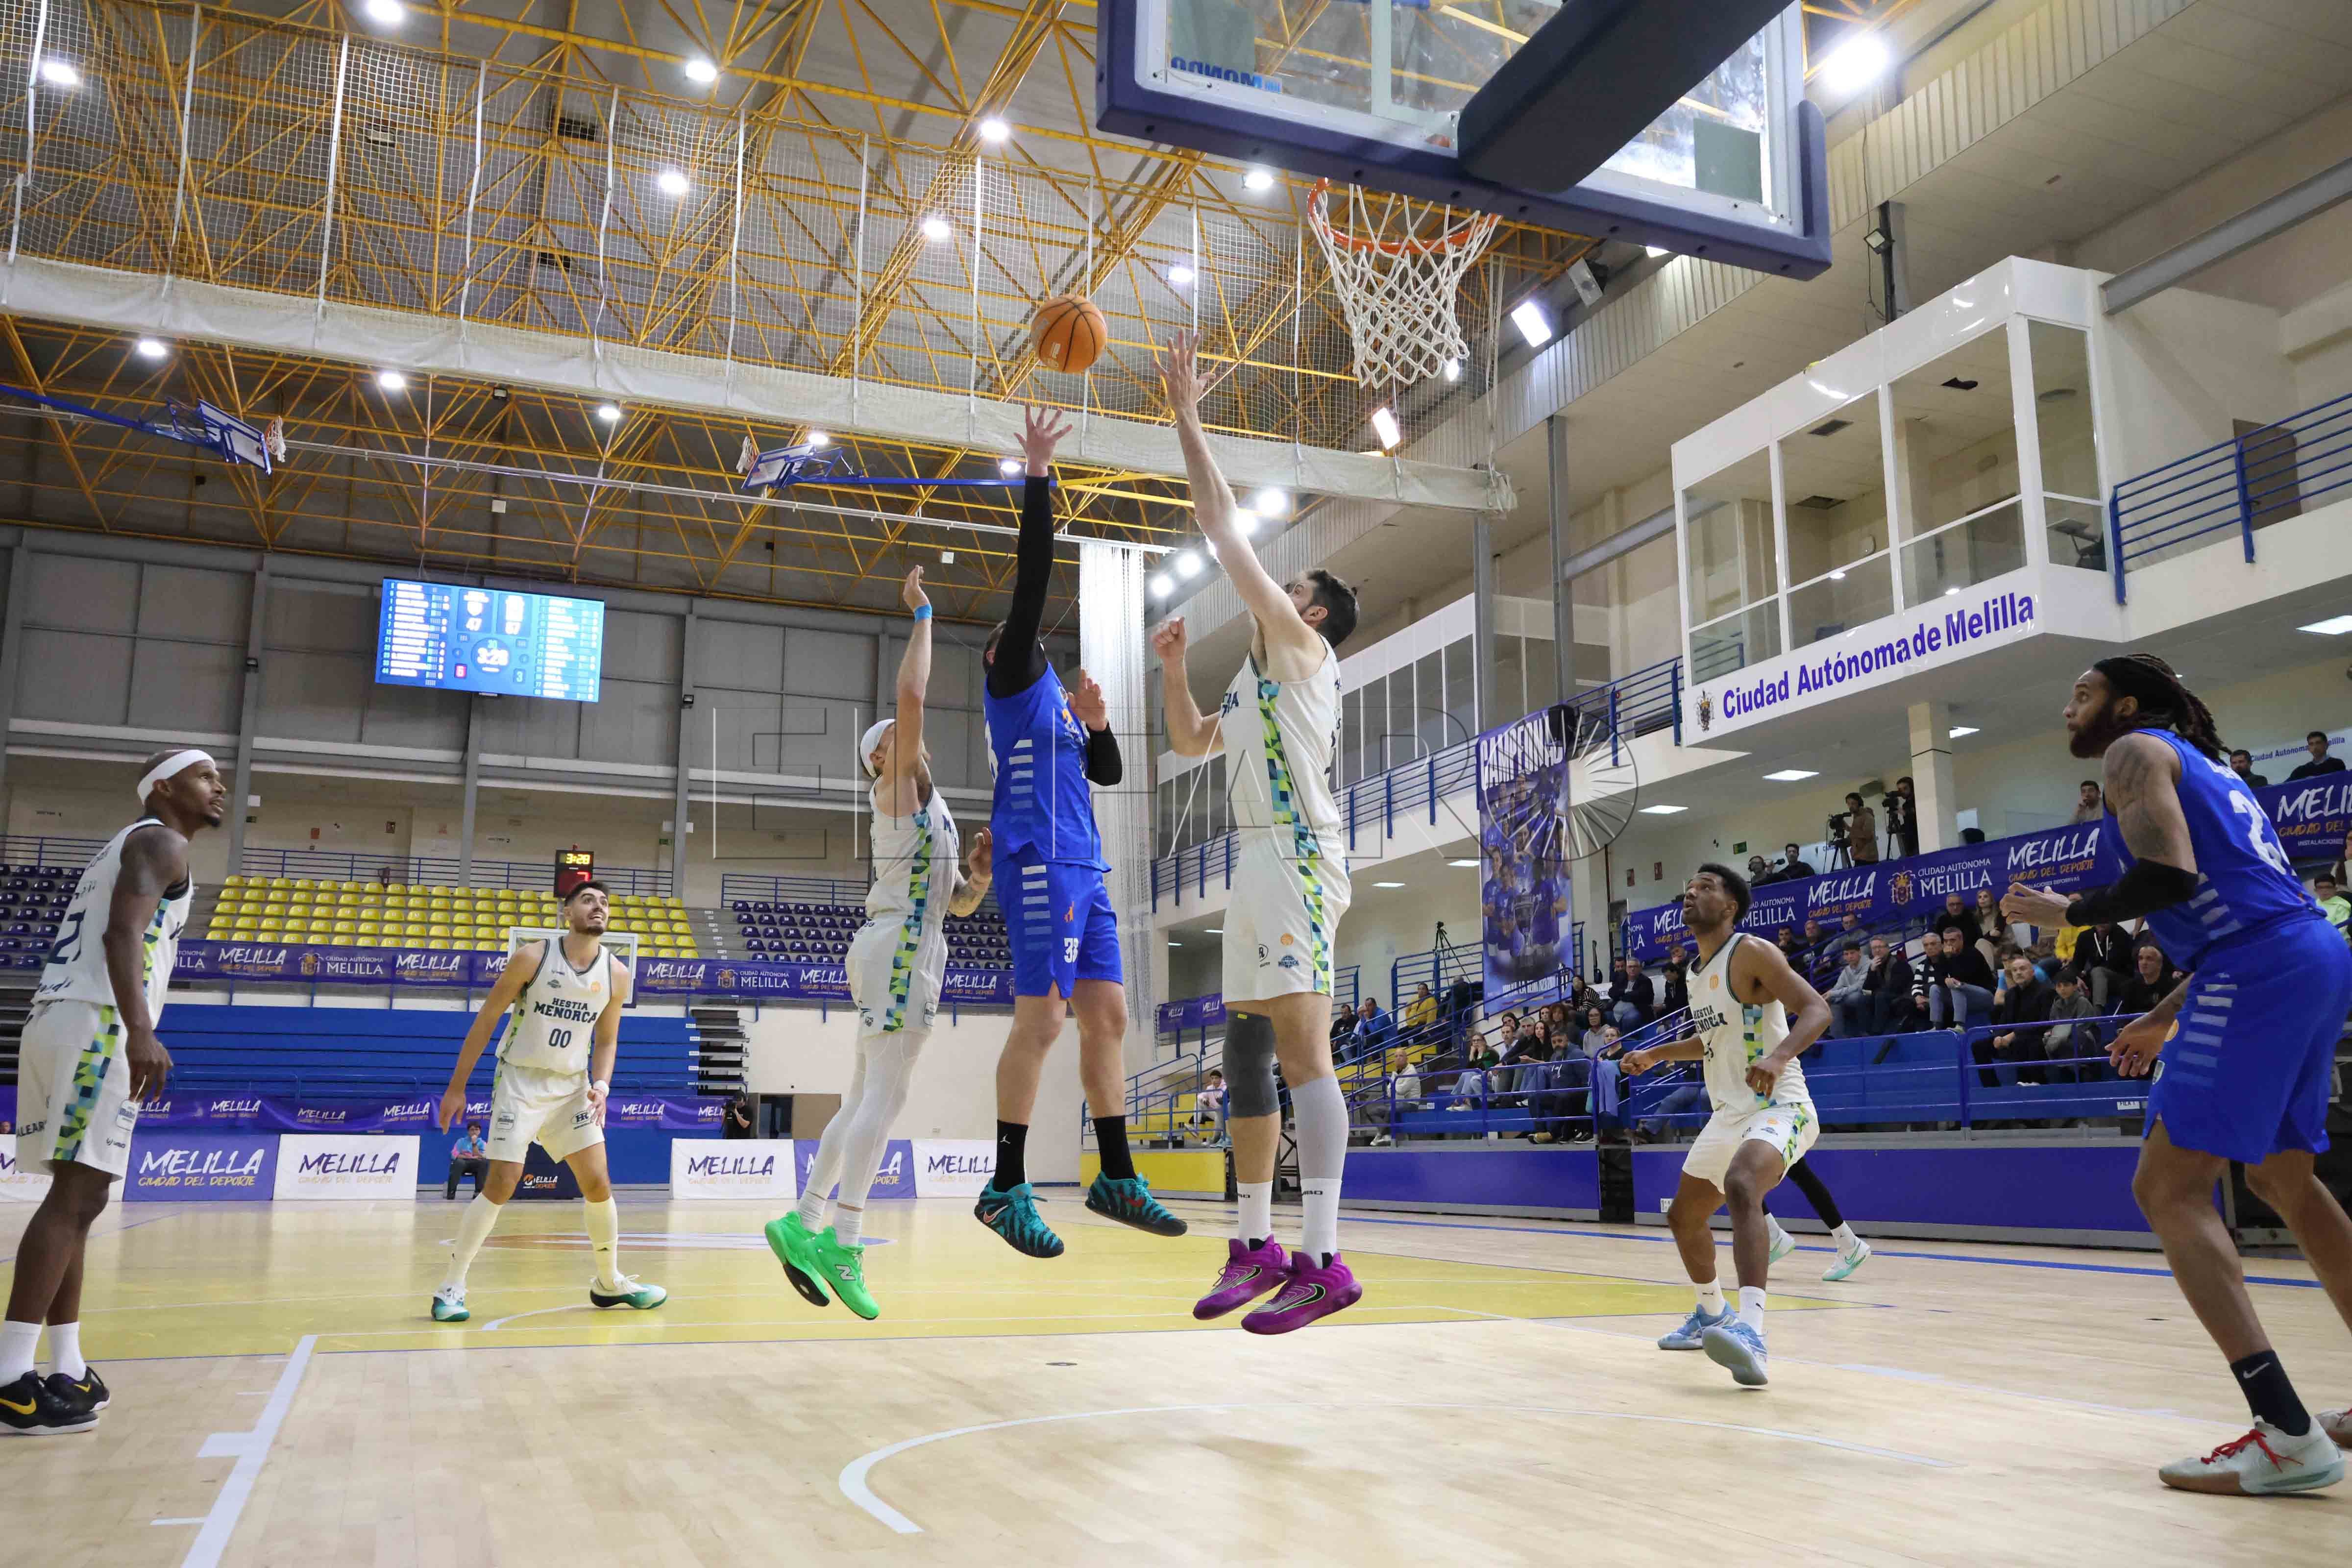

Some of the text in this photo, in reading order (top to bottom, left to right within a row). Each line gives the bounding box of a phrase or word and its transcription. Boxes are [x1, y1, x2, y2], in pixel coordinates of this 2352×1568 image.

[1723, 592, 2034, 719] Ciudad Autónoma de Melilla
[2007, 828, 2101, 870] MELILLA
[565, 853, 590, 865] 3:28
[1918, 865, 1945, 876] CIUDAD
[2009, 859, 2094, 882] CIUDAD DEL DEPORTE
[1808, 871, 1876, 907] MELILLA
[1920, 870, 1992, 898] MELILLA
[1742, 906, 1796, 929] MELILLA
[1808, 907, 1831, 919] CIUDAD
[1832, 905, 1843, 914] DEL
[174, 957, 205, 969] ILLA
[219, 948, 287, 965] MELILLA
[395, 954, 461, 971] MELILLA
[327, 963, 383, 975] MELILLA
[647, 963, 706, 980] MELILLA
[741, 977, 790, 988] MELILLA
[945, 975, 996, 989] MELILLA
[534, 1001, 598, 1023] MENORCA
[552, 997, 588, 1010] HESTIA
[548, 1028, 572, 1048] 00
[211, 1100, 262, 1113] MELILLA
[297, 1108, 346, 1120] MELILLA
[384, 1102, 430, 1117] MELILLA
[621, 1103, 665, 1115] MELILLA
[139, 1149, 265, 1176] MELILLA
[299, 1152, 400, 1175] MELILLA
[687, 1155, 774, 1176] MELILLA
[138, 1176, 255, 1188] CIUDAD DEL DEPORTE
